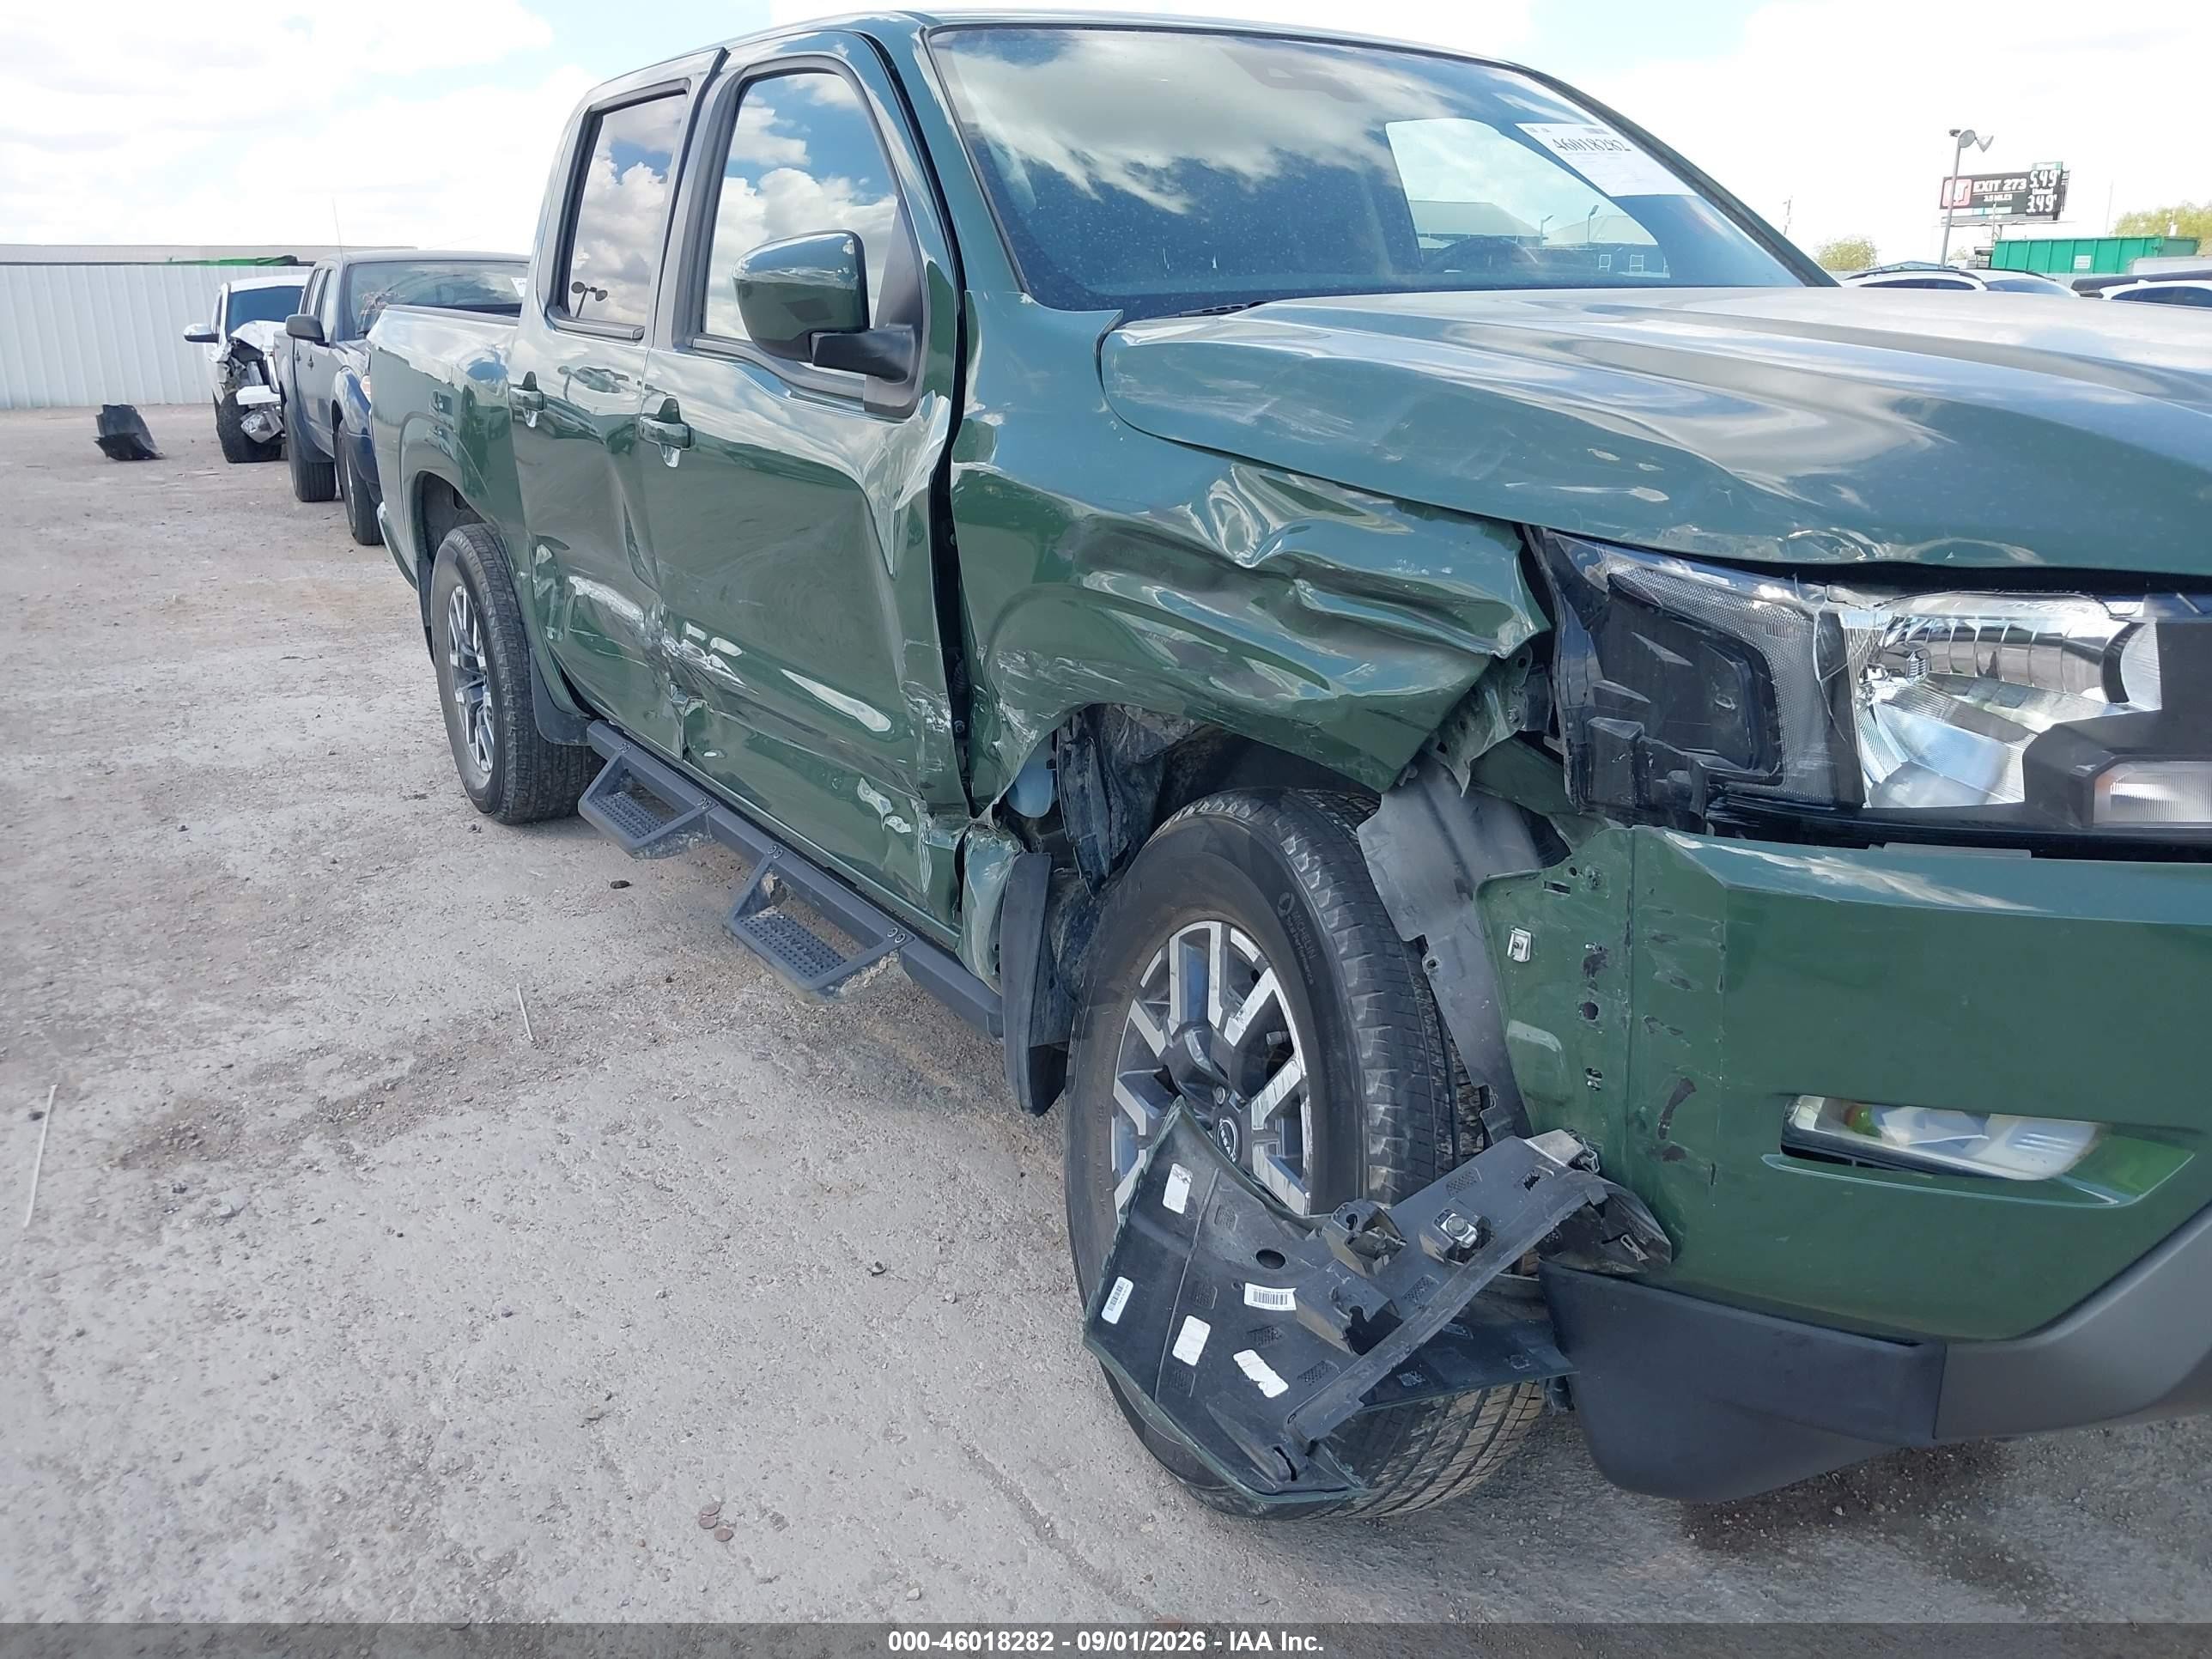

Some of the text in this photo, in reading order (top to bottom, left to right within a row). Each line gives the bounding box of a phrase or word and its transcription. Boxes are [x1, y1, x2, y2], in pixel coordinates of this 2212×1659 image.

[1553, 137, 1632, 152] 46018282
[1972, 178, 2027, 193] EXIT 273
[1291, 910, 1317, 959] MICHELIN
